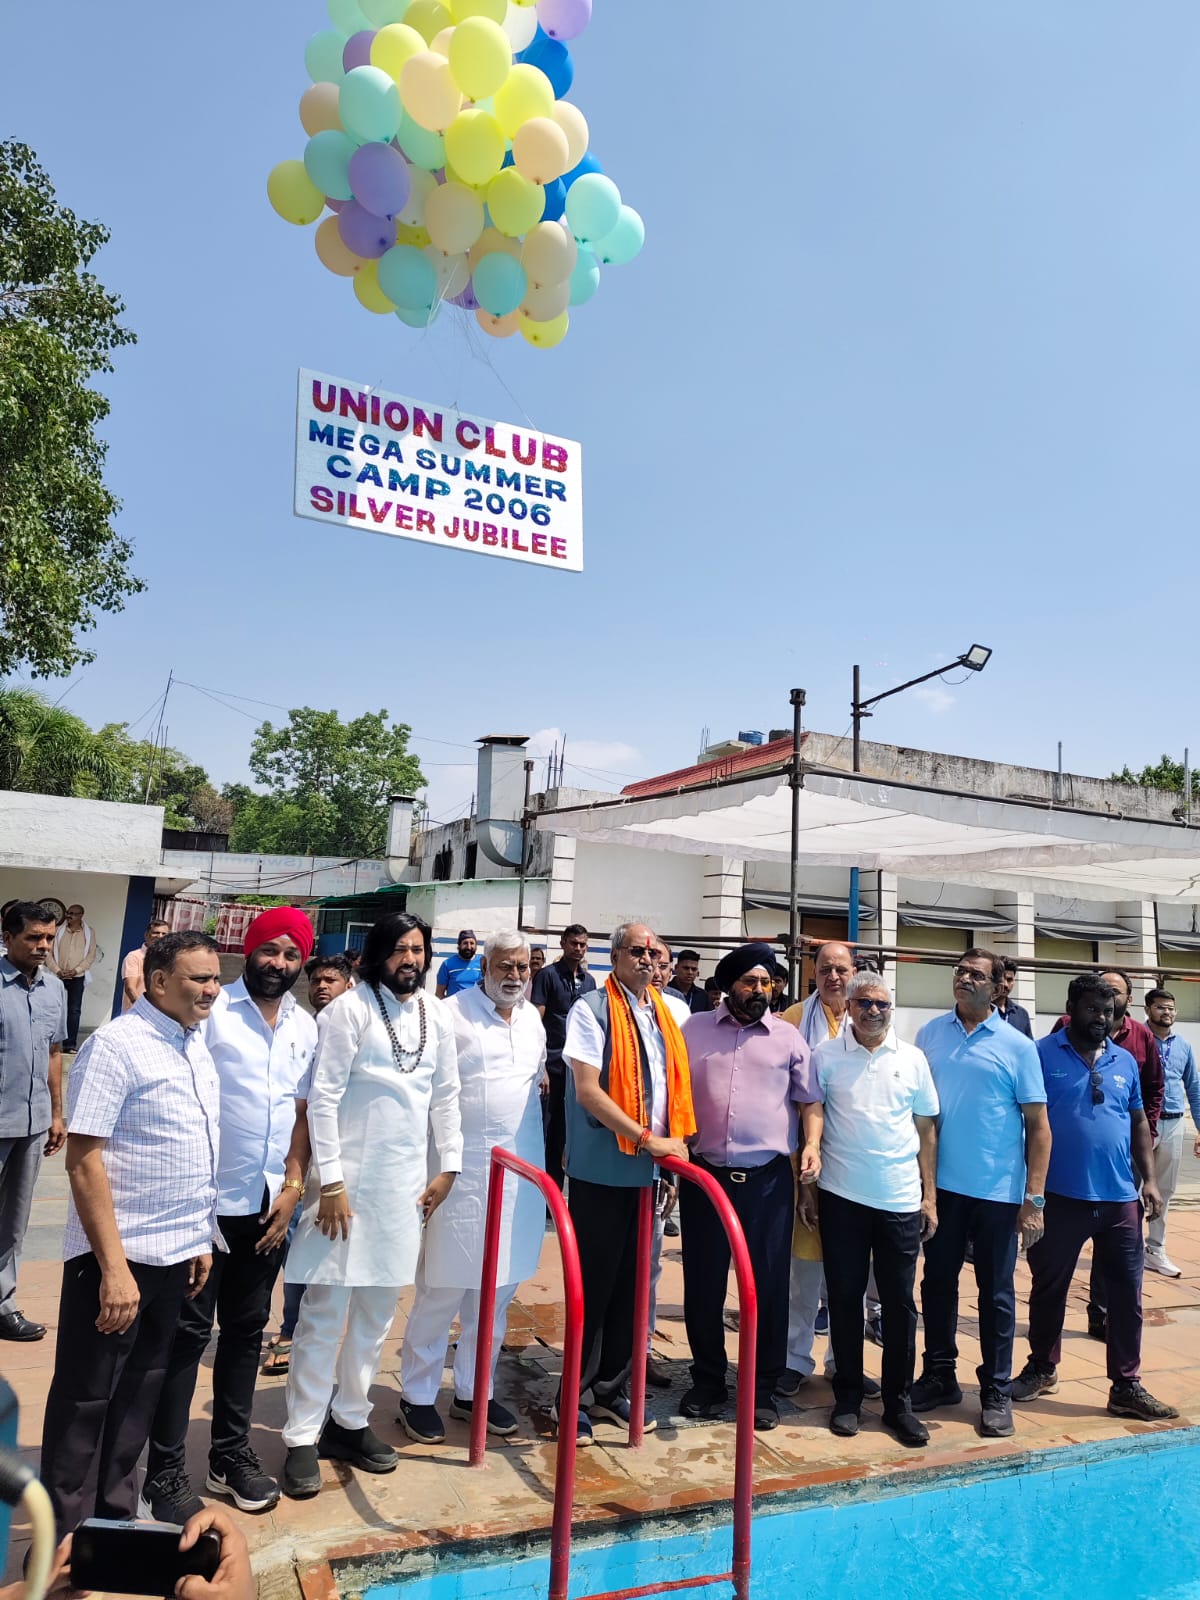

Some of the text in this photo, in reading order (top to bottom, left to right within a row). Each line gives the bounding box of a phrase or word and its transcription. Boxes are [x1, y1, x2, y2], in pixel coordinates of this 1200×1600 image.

[308, 419, 567, 502] MEGA SUMMER
[312, 379, 569, 473] UNION CLUB
[309, 485, 567, 560] SILVER JUBILEE
[326, 455, 552, 526] CAMP 2006
